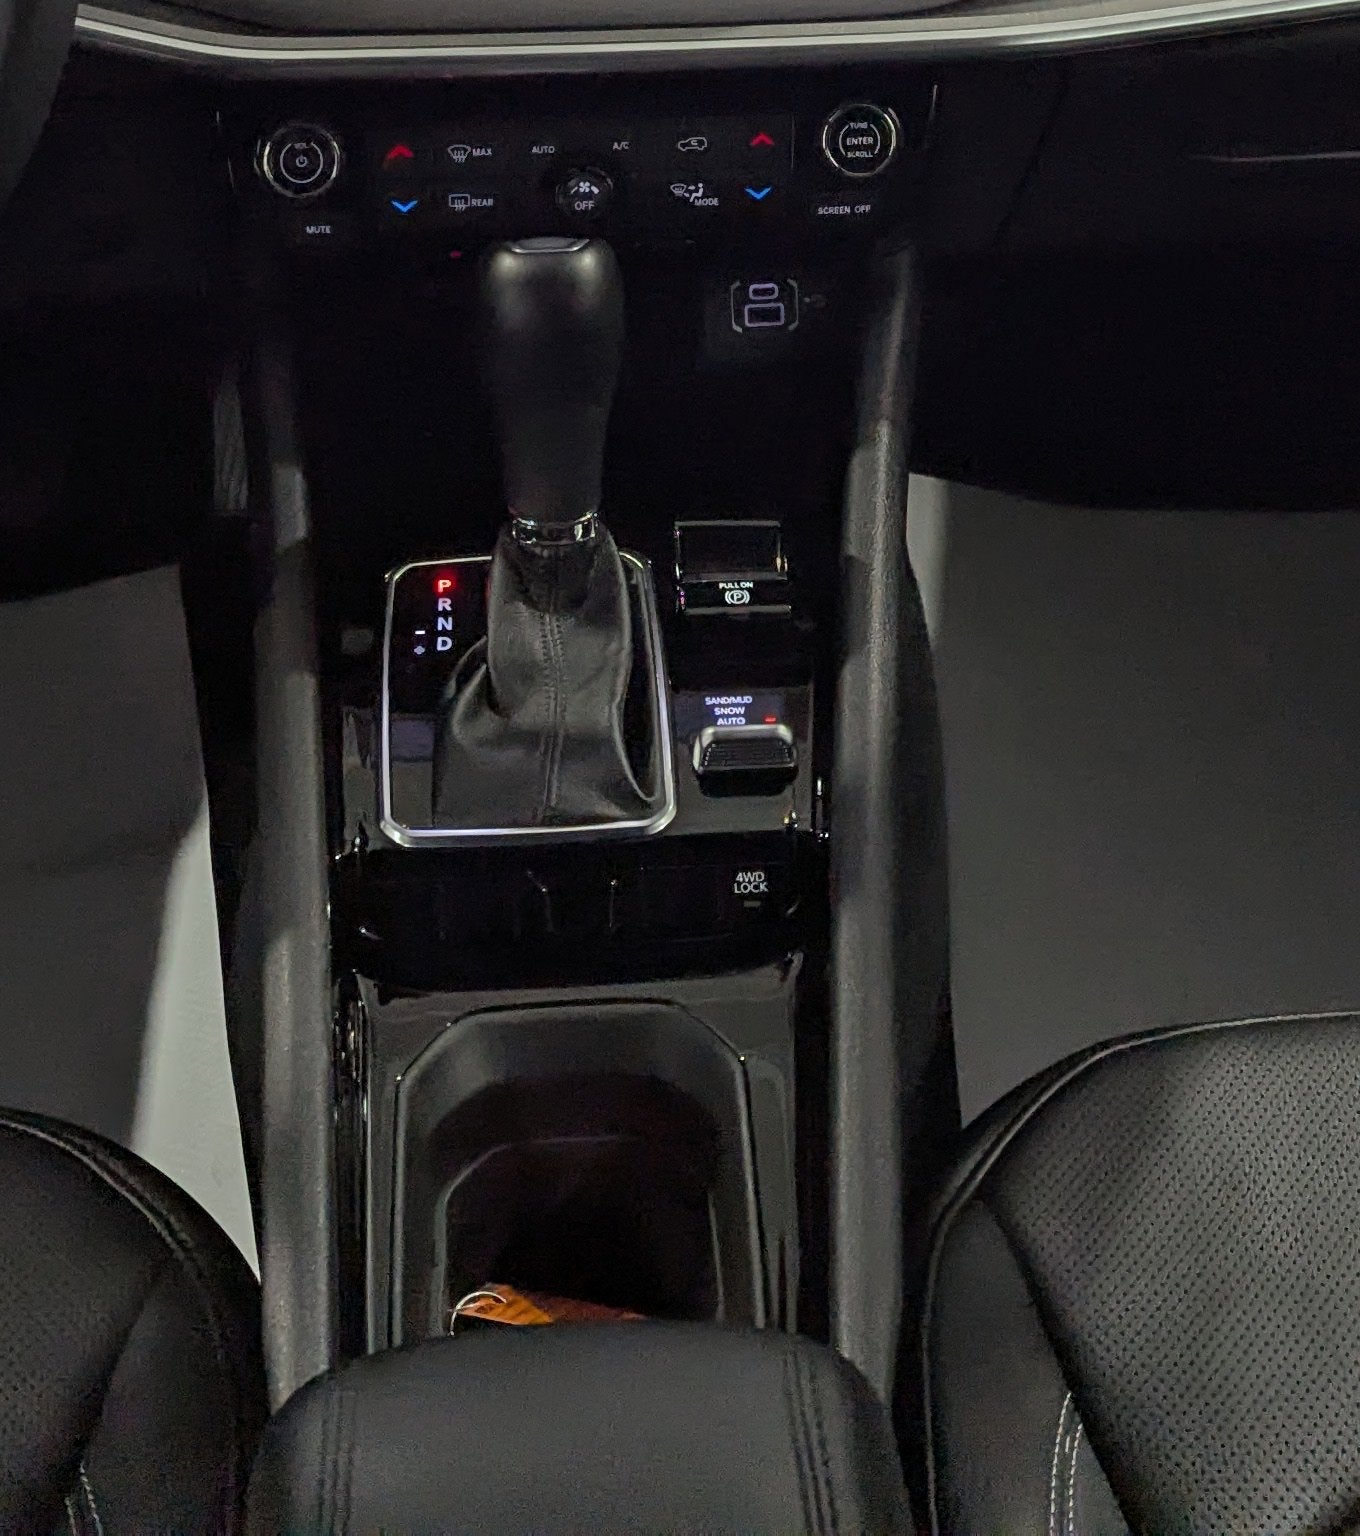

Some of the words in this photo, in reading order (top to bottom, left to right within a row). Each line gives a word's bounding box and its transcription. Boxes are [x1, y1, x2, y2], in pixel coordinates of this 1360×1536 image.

[612, 141, 629, 151] A/C
[846, 136, 874, 146] ENTER
[472, 147, 492, 157] MAX
[531, 145, 555, 154] AUTO
[471, 198, 494, 207] REAR
[575, 201, 595, 211] OFF
[694, 196, 719, 206] MODE
[817, 205, 851, 215] SCREEN
[854, 204, 871, 214] OFF
[305, 225, 331, 234] MUTE
[437, 579, 452, 593] P
[719, 581, 740, 589] PULL
[740, 581, 754, 589] ON
[437, 597, 452, 612] R
[437, 616, 453, 631] N
[436, 636, 453, 652] D
[714, 706, 746, 716] SNOW
[716, 716, 746, 726] AUTO
[735, 871, 765, 882] 4WD
[733, 881, 769, 894] LOCK
